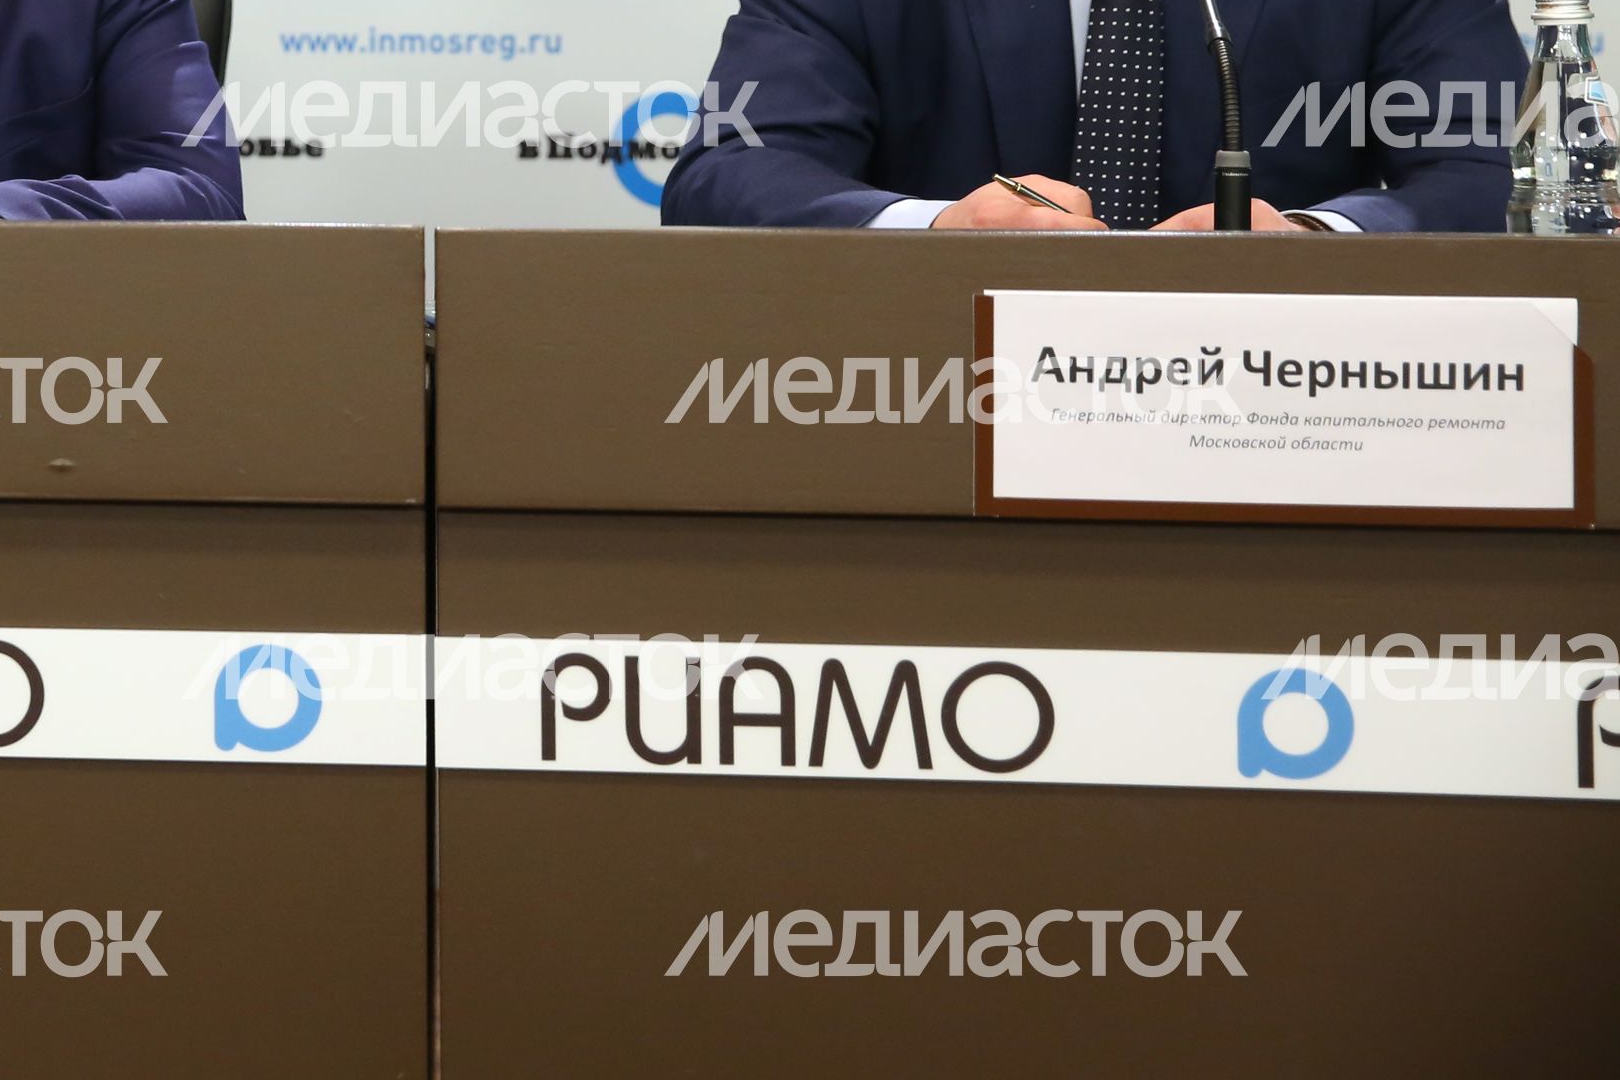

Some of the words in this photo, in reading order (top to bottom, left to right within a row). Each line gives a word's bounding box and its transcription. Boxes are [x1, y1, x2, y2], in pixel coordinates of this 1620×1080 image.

[279, 25, 563, 62] www.inmosreg.ru
[547, 133, 680, 165] Подмо
[1031, 345, 1226, 395] Андрей
[1242, 349, 1527, 398] Чернышин
[1051, 408, 1157, 425] Генеральный
[1160, 410, 1242, 427] директор
[1246, 411, 1299, 426] Фонда
[1303, 414, 1424, 430] капитального
[1427, 417, 1506, 431] ремонта
[1189, 434, 1286, 450] Московской
[1290, 436, 1364, 452] области
[541, 652, 1056, 774] РИАМО
